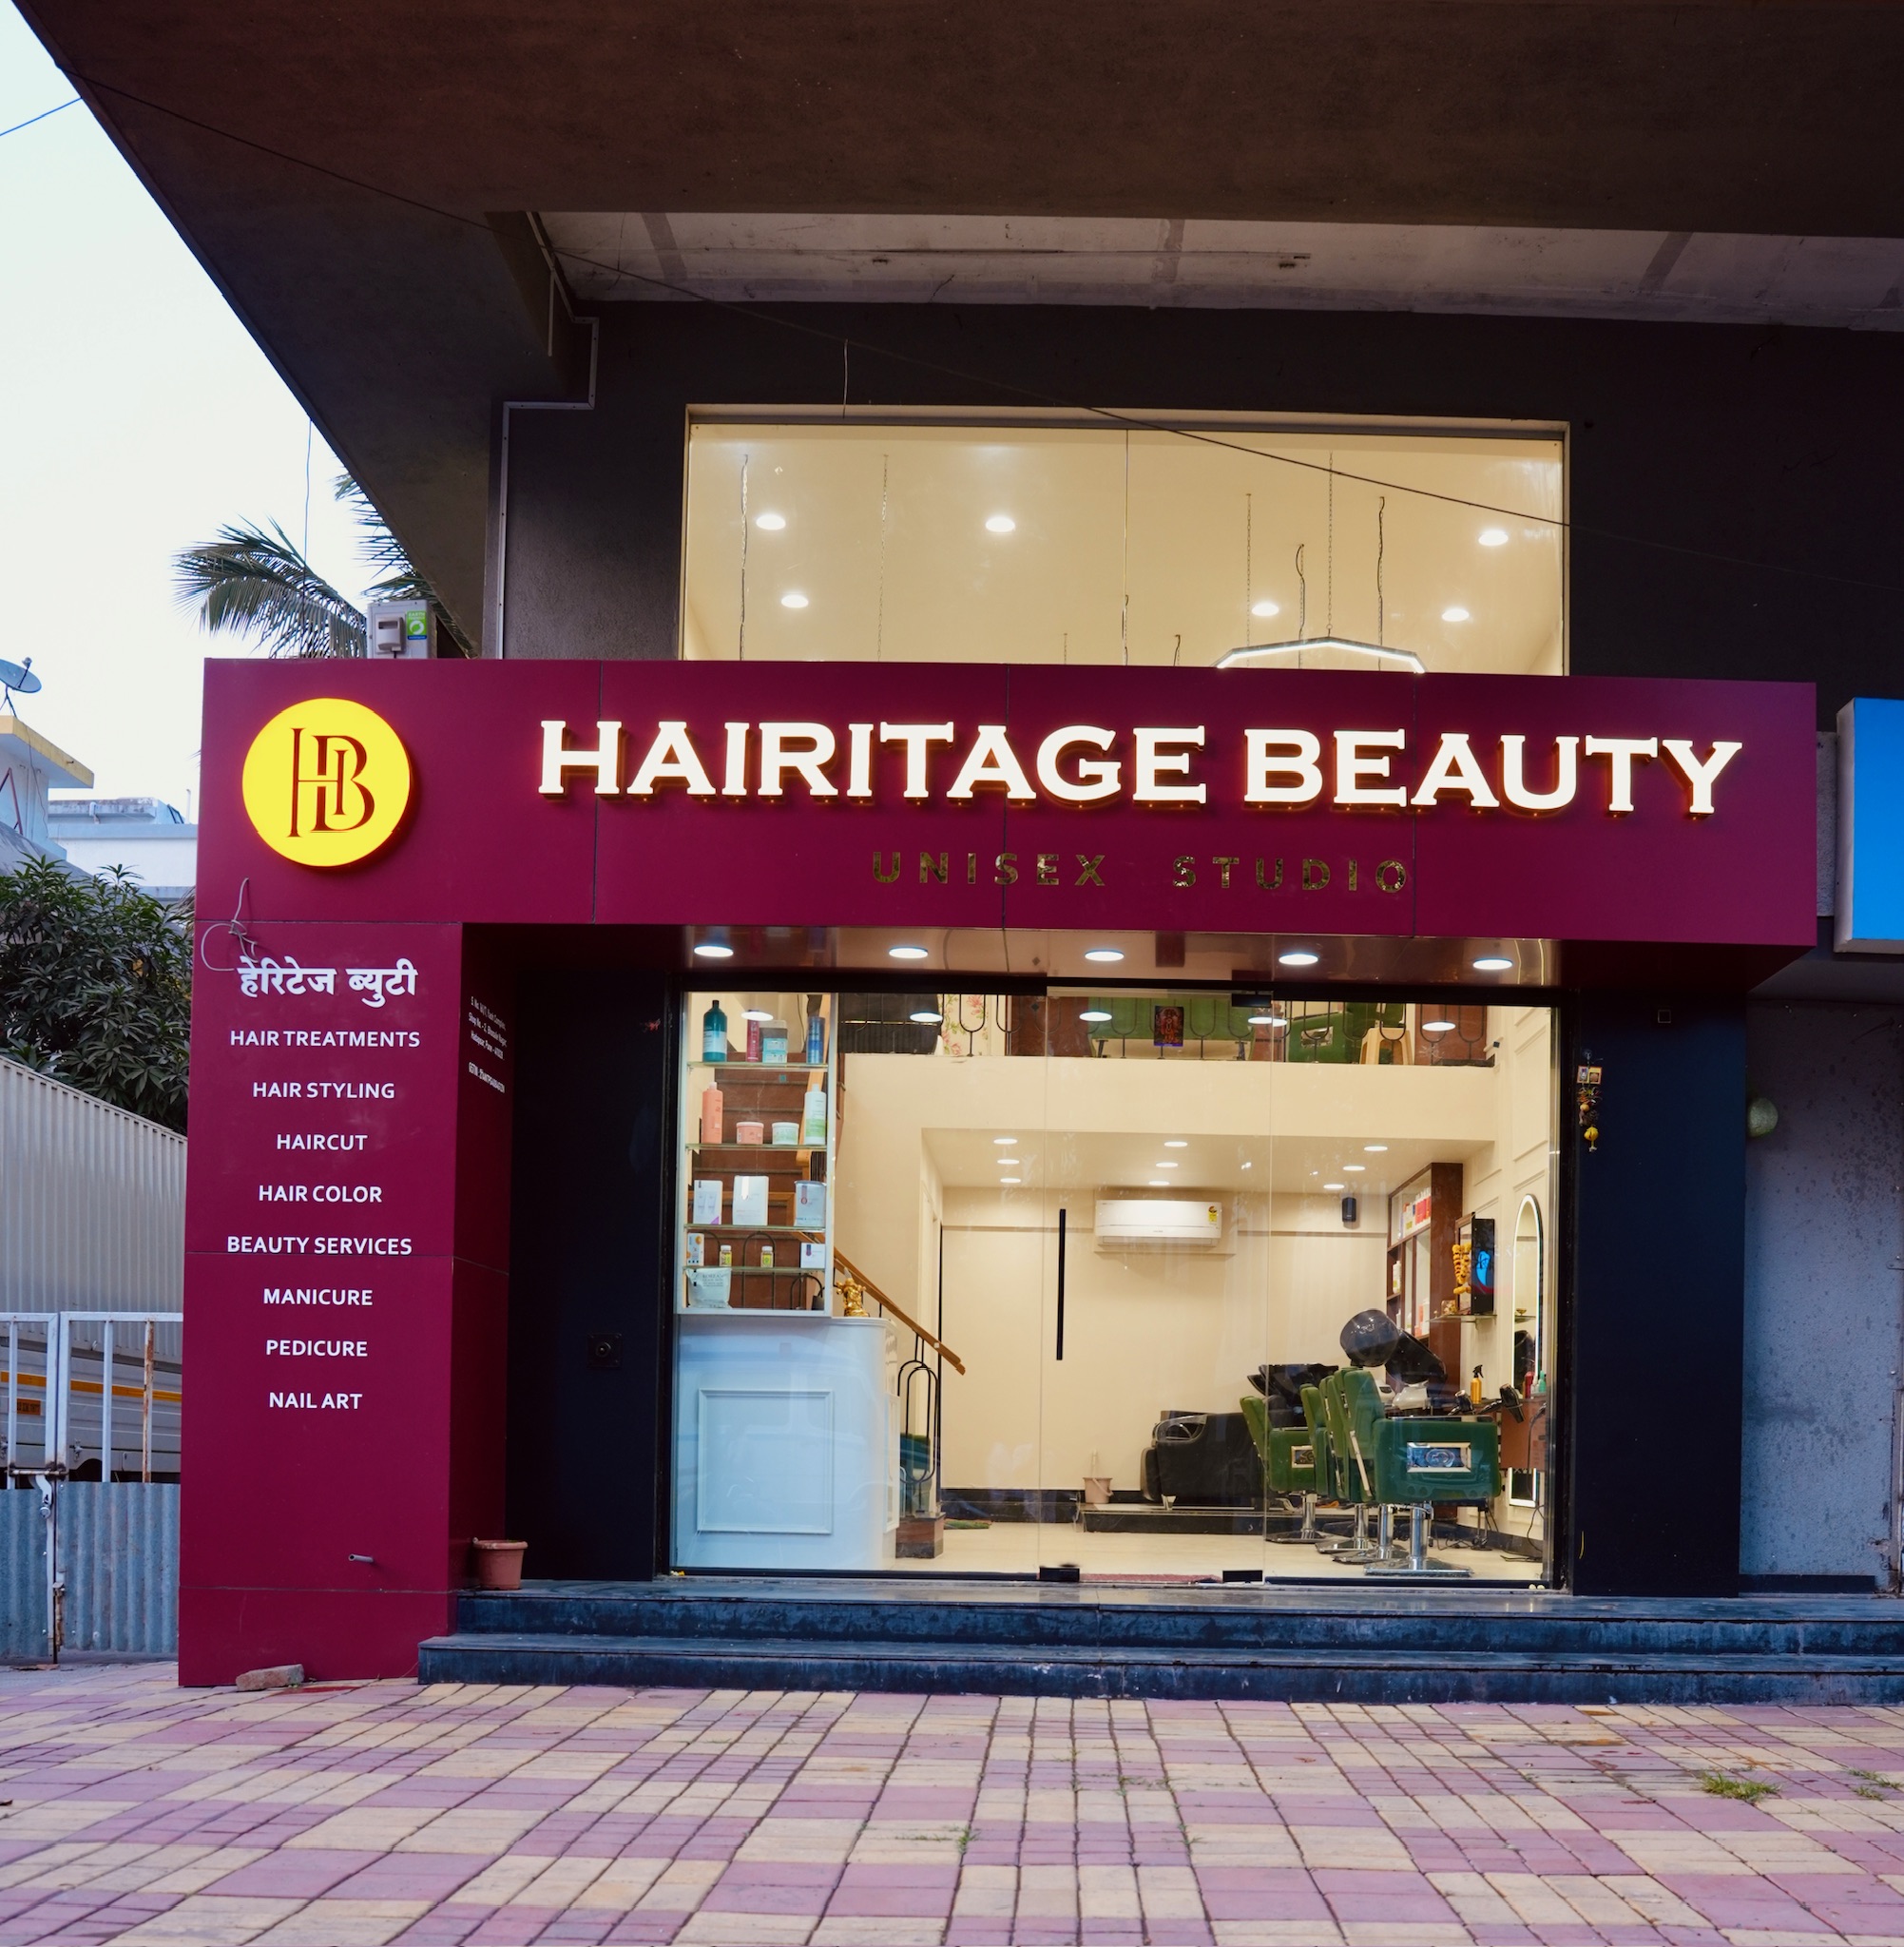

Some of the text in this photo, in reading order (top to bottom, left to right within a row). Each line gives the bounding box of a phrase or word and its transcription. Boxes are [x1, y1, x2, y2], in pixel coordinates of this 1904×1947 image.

[538, 720, 1743, 815] HAIRITAGE BEAUTY
[872, 851, 1408, 894] UNISEX STUDIO
[237, 955, 419, 1009] हेरिटेज ब्युटी
[230, 1030, 420, 1048] HAIR TREATMENTS
[253, 1082, 394, 1099] HAIR STYLING
[277, 1133, 368, 1151] HAIRCUT
[259, 1185, 382, 1203] HAIR COLOR
[227, 1236, 413, 1256] BEAUTY SERVICES
[263, 1288, 374, 1306] MANICURE
[266, 1340, 368, 1357] PEDICURE
[269, 1392, 363, 1410] NAIL ART
